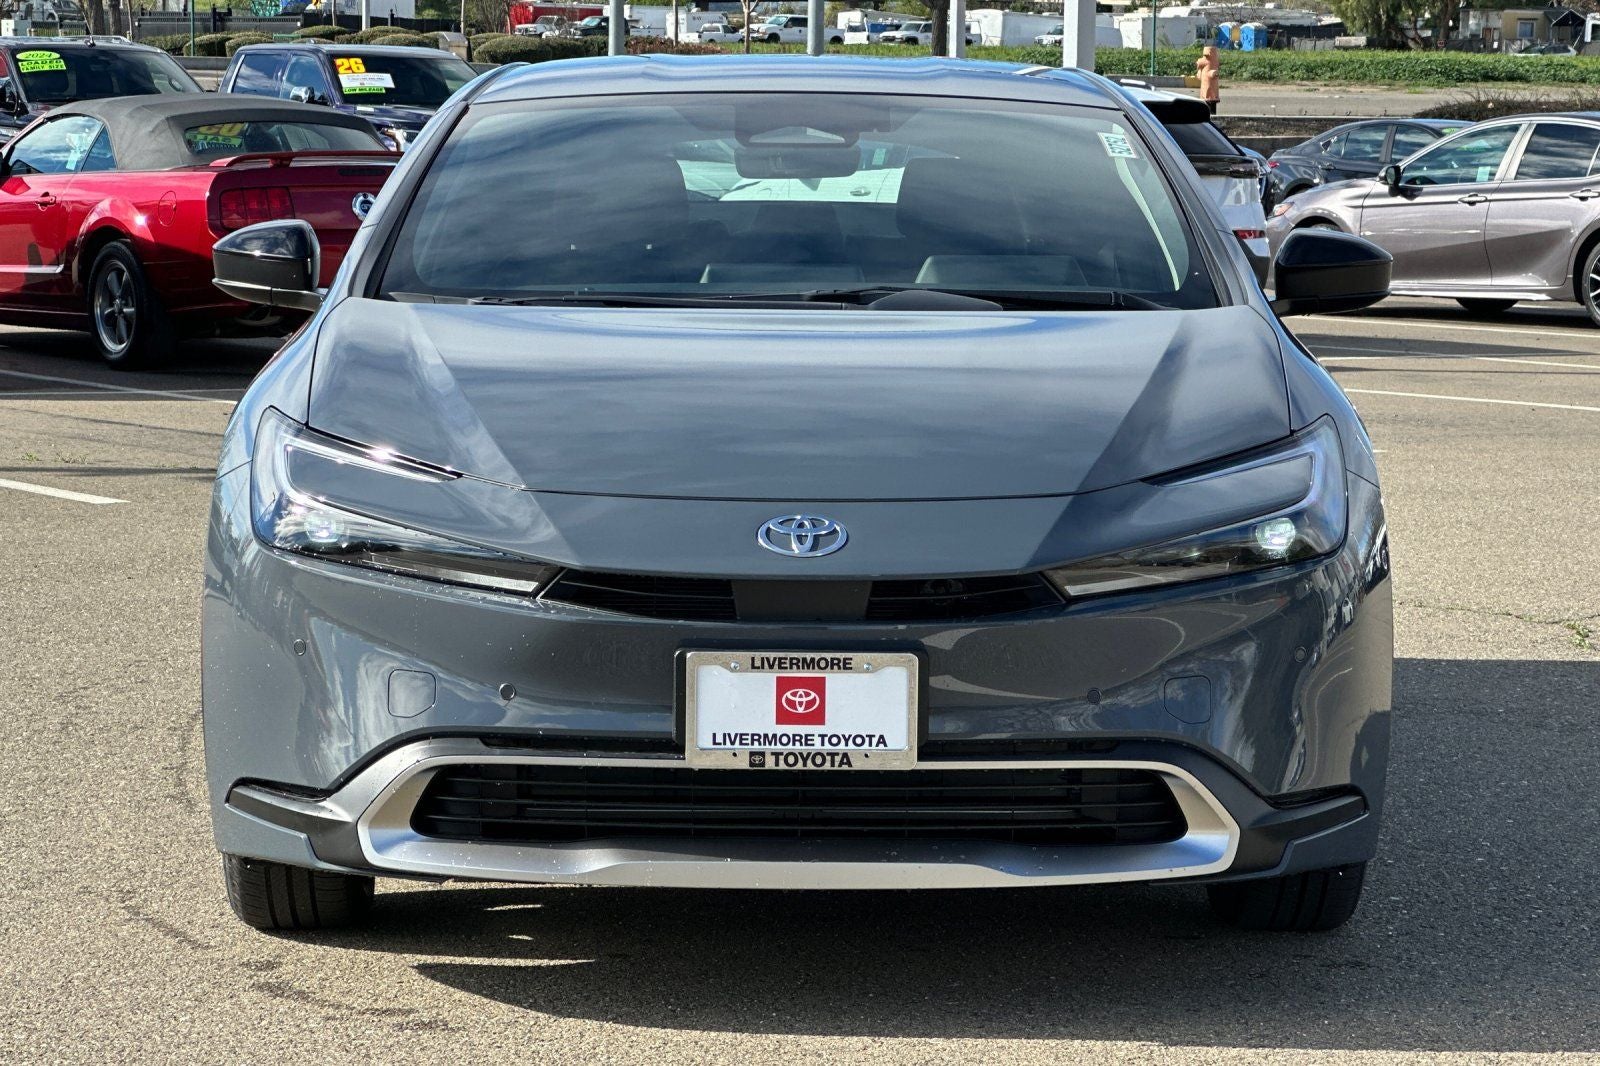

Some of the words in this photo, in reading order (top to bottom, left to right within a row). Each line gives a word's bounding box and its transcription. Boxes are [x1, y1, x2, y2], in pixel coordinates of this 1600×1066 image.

[335, 57, 366, 74] 26
[750, 656, 853, 670] LIVERMORE
[712, 732, 815, 747] LIVERMORE
[817, 734, 888, 747] TOYOTA
[771, 752, 853, 768] TOYOTA
